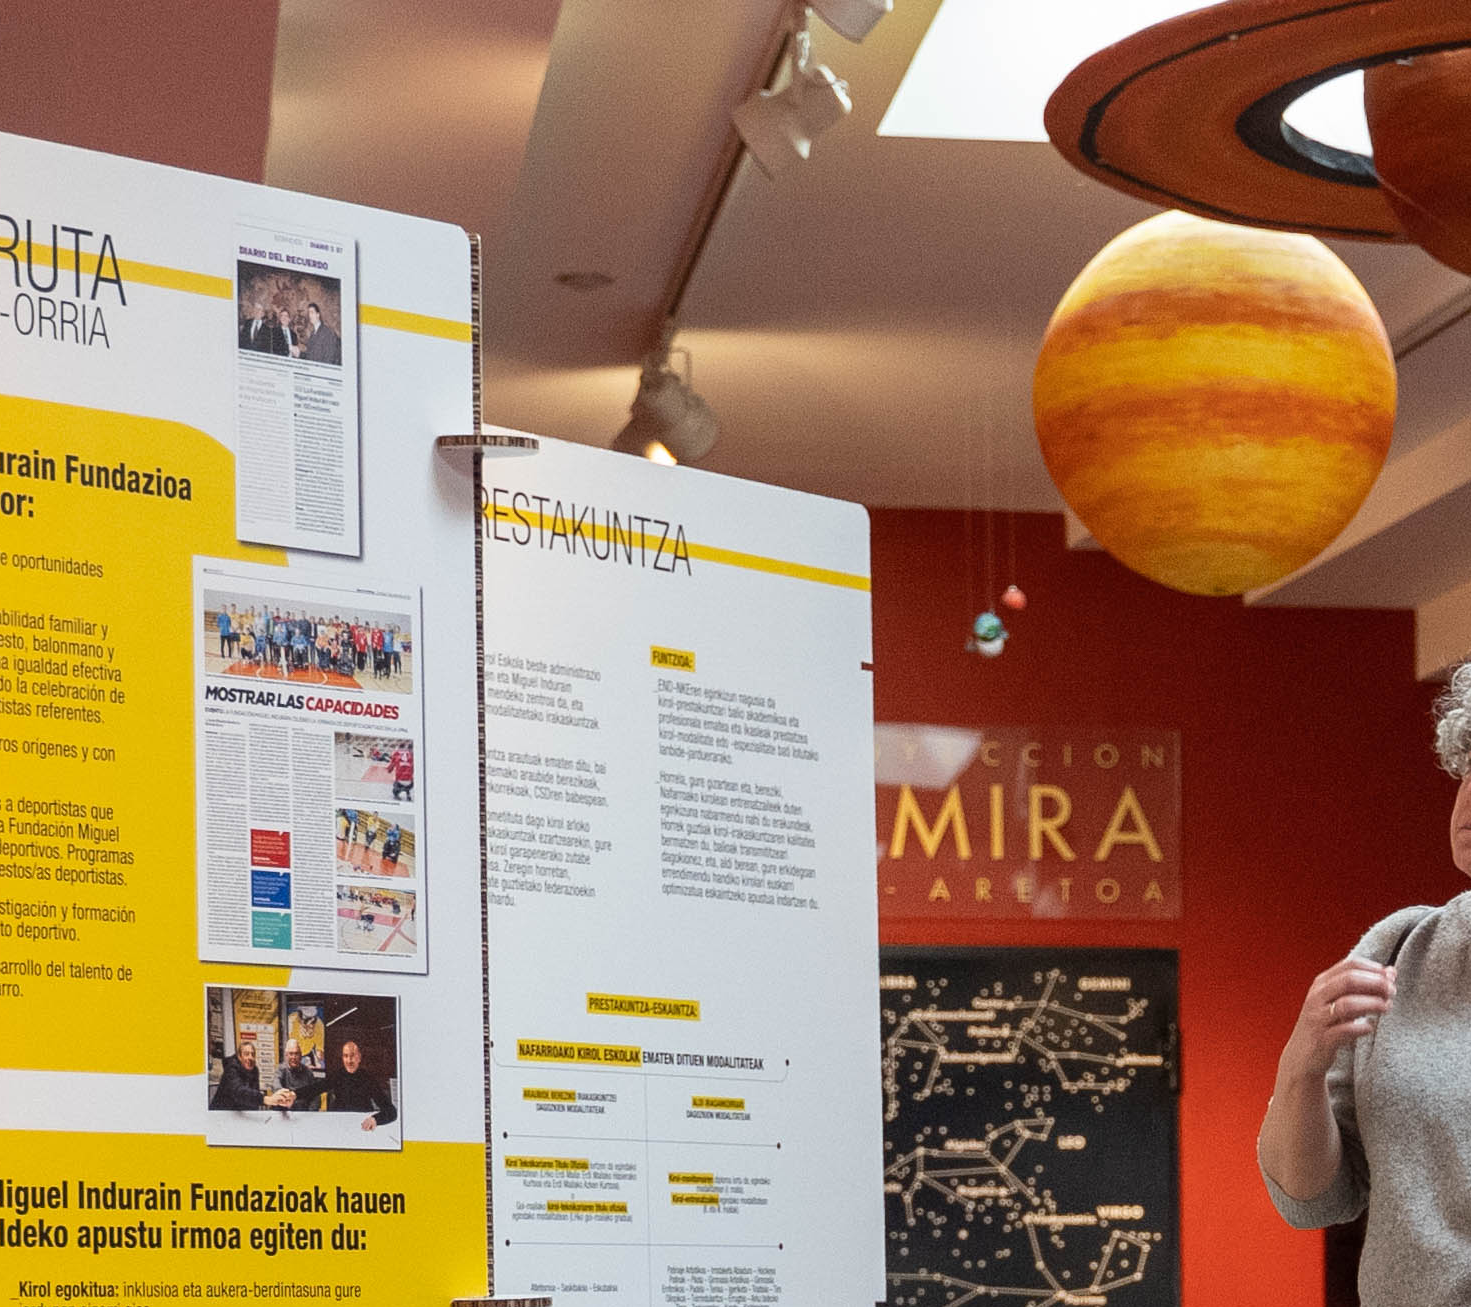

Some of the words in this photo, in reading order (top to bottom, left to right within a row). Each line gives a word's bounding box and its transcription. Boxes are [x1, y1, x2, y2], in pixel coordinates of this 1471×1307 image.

[239, 246, 266, 259] DIARIO
[269, 251, 284, 262] DEL
[286, 254, 328, 270] RECUERDO
[66, 455, 192, 501] Fundazioa
[48, 613, 98, 636] familiar
[99, 623, 110, 641] y
[13, 654, 69, 677] igualdad
[71, 661, 122, 682] efectiva
[35, 701, 105, 724] referentes.
[206, 686, 276, 706] MOSTRAR
[277, 694, 304, 709] LAS
[306, 697, 399, 720] CAPACIDADES
[889, 784, 1164, 861] MIRA
[54, 864, 128, 887] deportistas.
[45, 960, 66, 978] del
[69, 962, 114, 980] talento
[115, 964, 134, 981] de
[519, 1043, 574, 1059] NAFARROAKO
[577, 1047, 601, 1061] KIROL
[604, 1048, 640, 1063] ESKOLAK
[643, 1051, 674, 1065] EMATEN
[676, 1053, 704, 1066] DITUEN
[707, 1056, 764, 1070] MODALITATEAK
[79, 1181, 181, 1211] Indurain
[191, 1183, 328, 1213] Fundazioak
[336, 1185, 405, 1214] hauen
[78, 1221, 162, 1255] apustu
[172, 1220, 241, 1248] irmoa
[250, 1220, 322, 1256] egiten
[331, 1221, 367, 1249] du:
